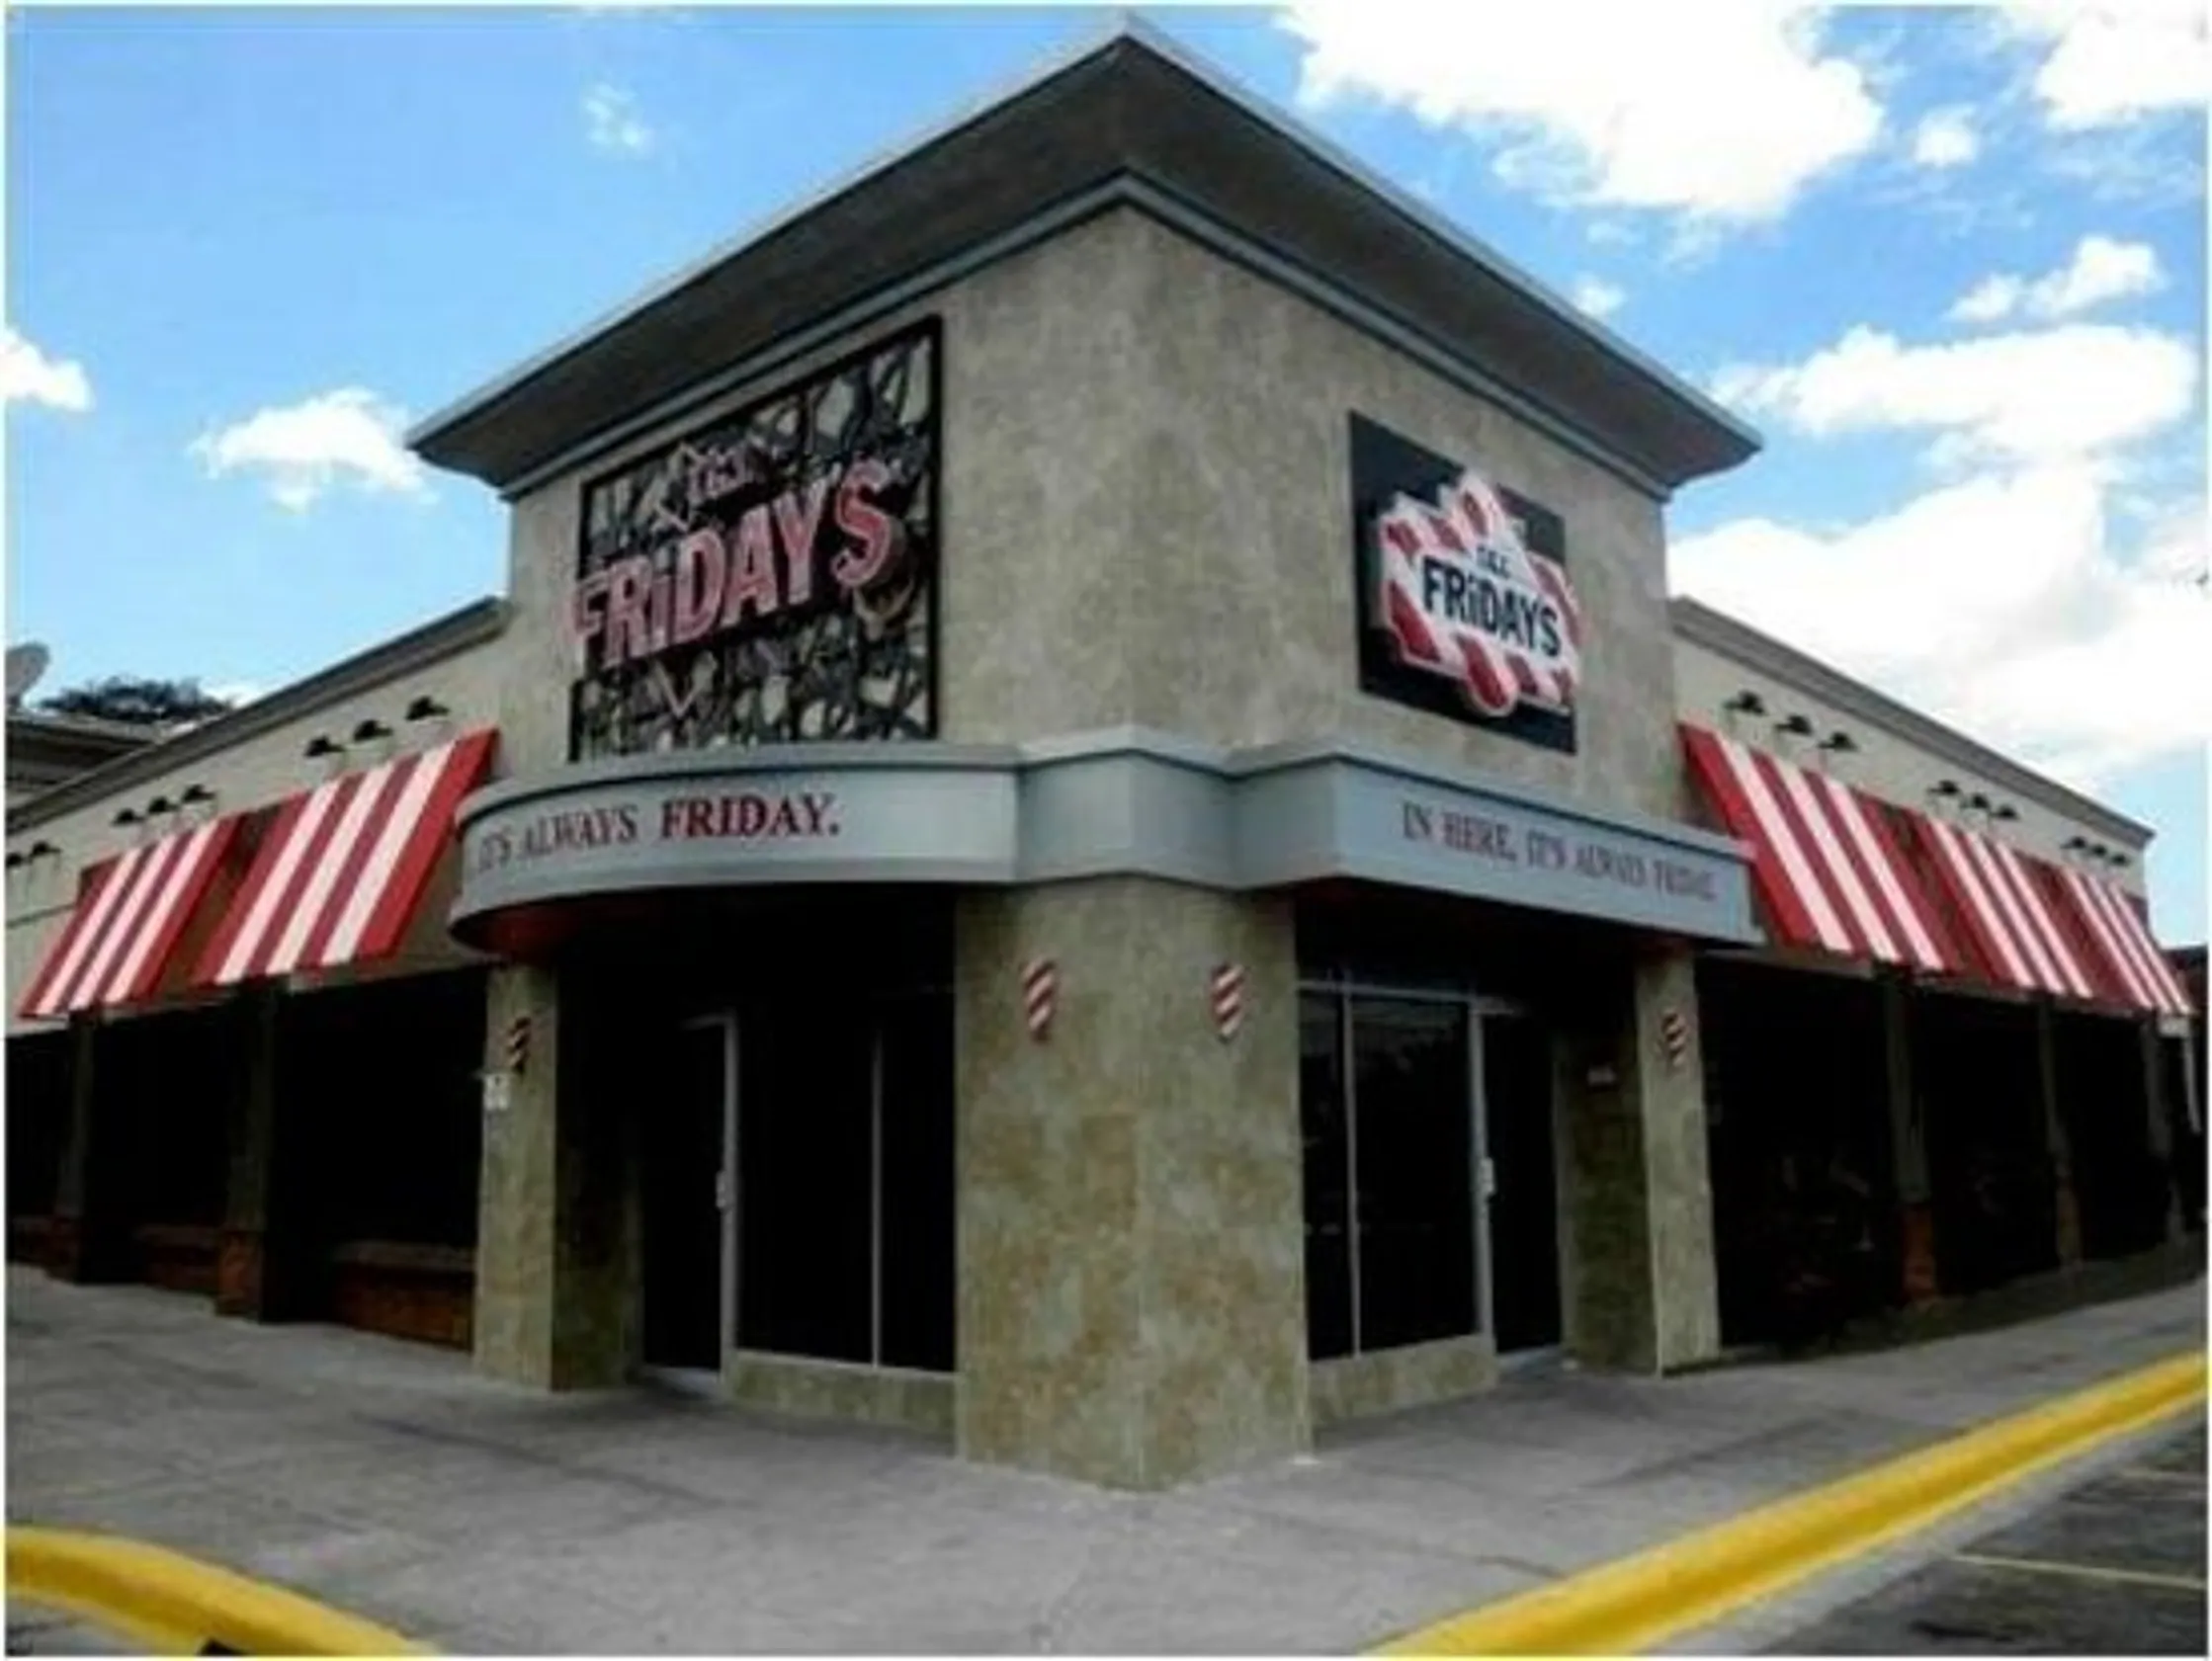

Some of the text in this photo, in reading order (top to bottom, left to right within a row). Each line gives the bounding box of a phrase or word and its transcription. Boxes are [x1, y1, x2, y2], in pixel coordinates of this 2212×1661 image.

[517, 802, 638, 861] ALWAYS
[659, 791, 840, 840] FRIDAY.
[1403, 800, 1433, 840] IN
